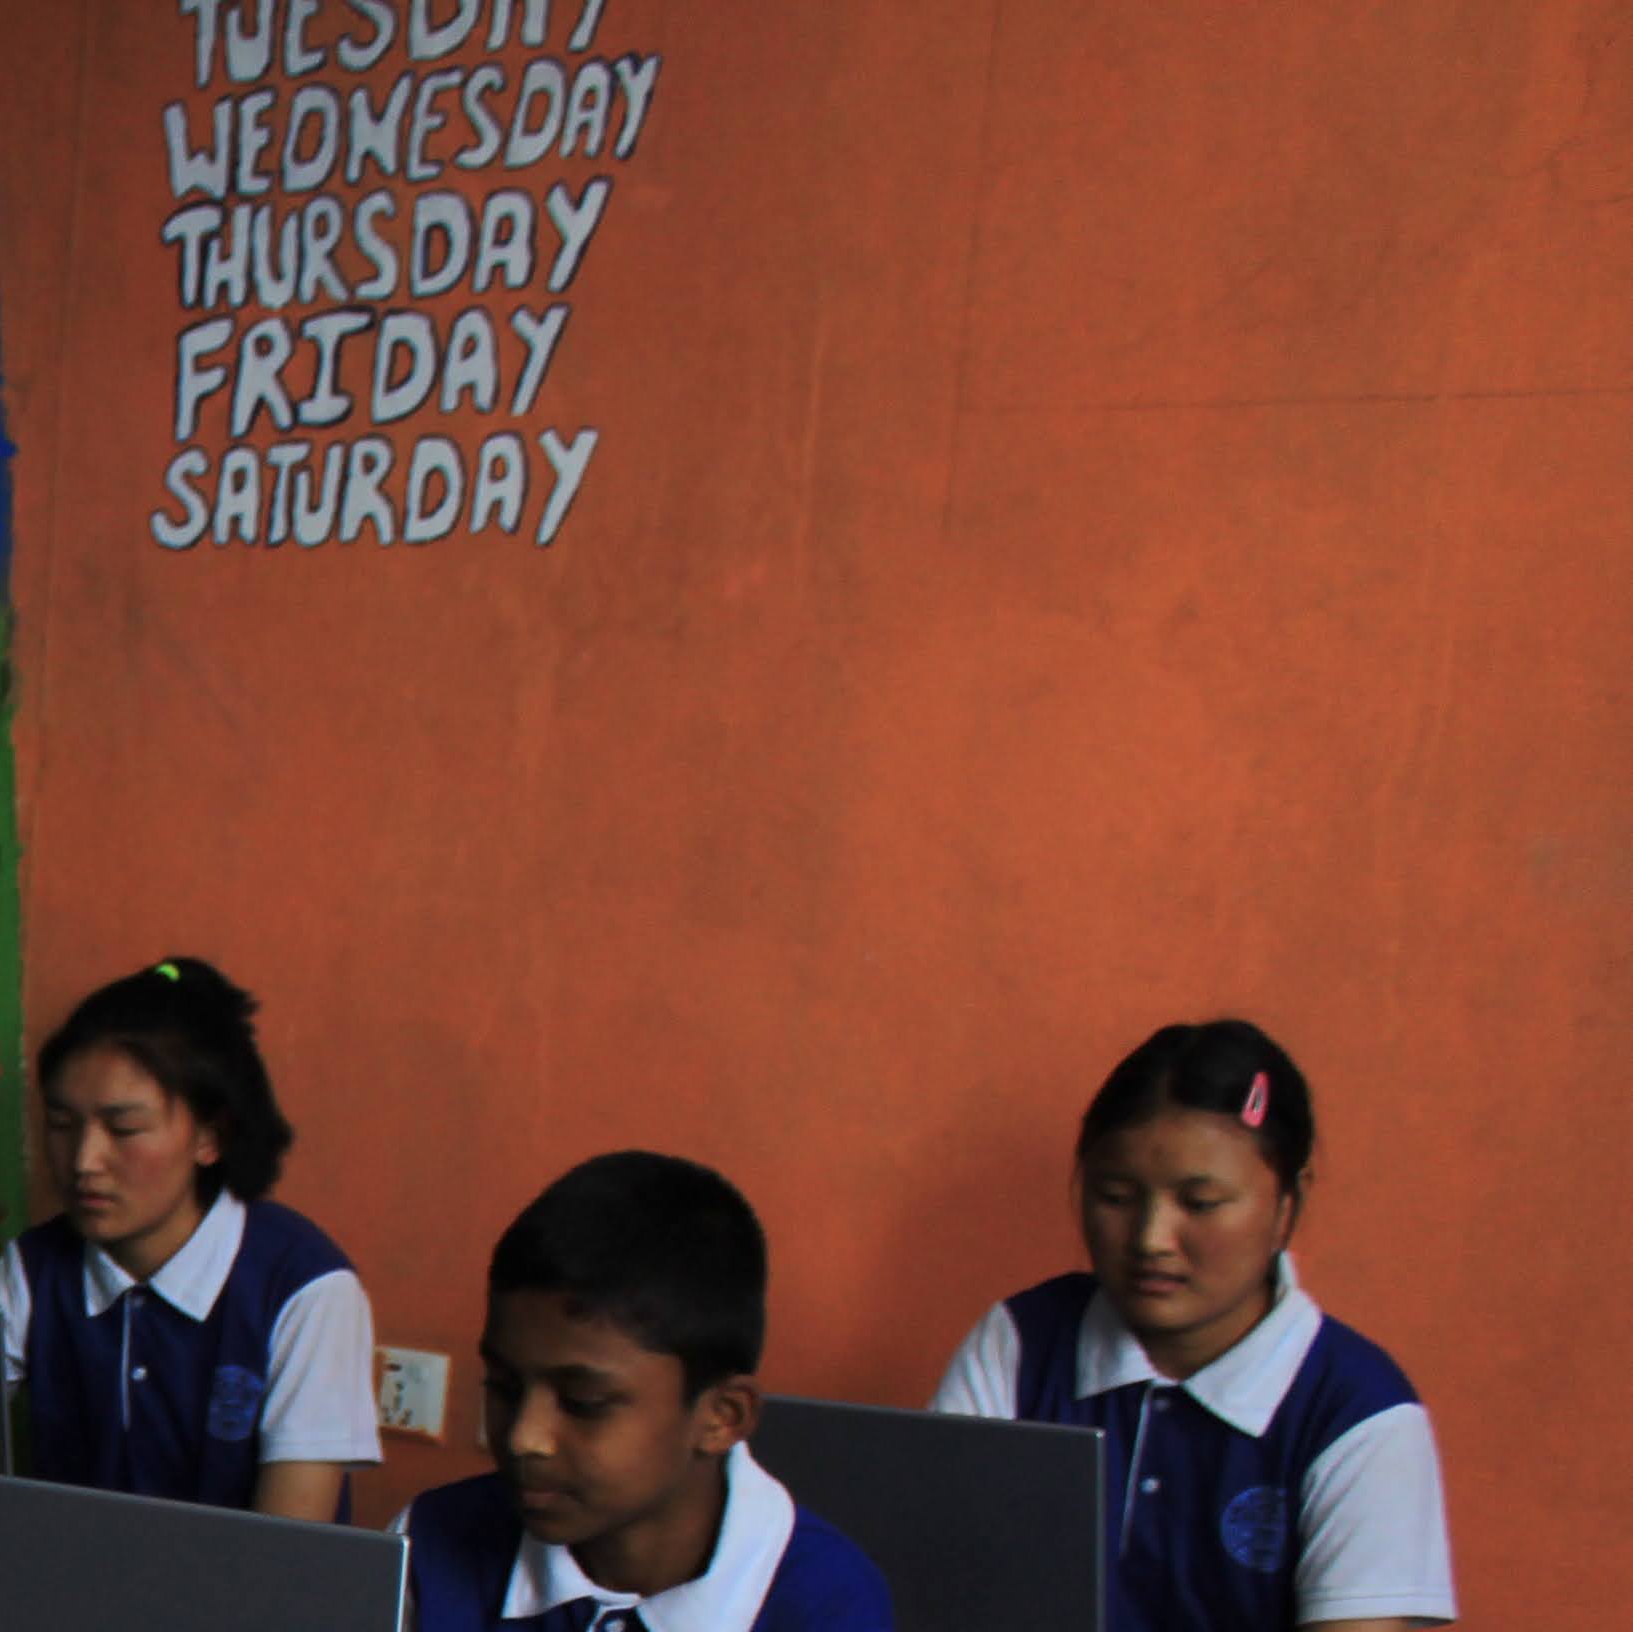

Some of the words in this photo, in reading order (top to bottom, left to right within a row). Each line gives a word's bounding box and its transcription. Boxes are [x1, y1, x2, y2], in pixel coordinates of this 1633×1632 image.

[162, 54, 661, 199] WEDNESDAY
[161, 176, 611, 309] THURSDAY
[174, 303, 570, 441] FRIDAY
[150, 427, 599, 548] SATURDAY
